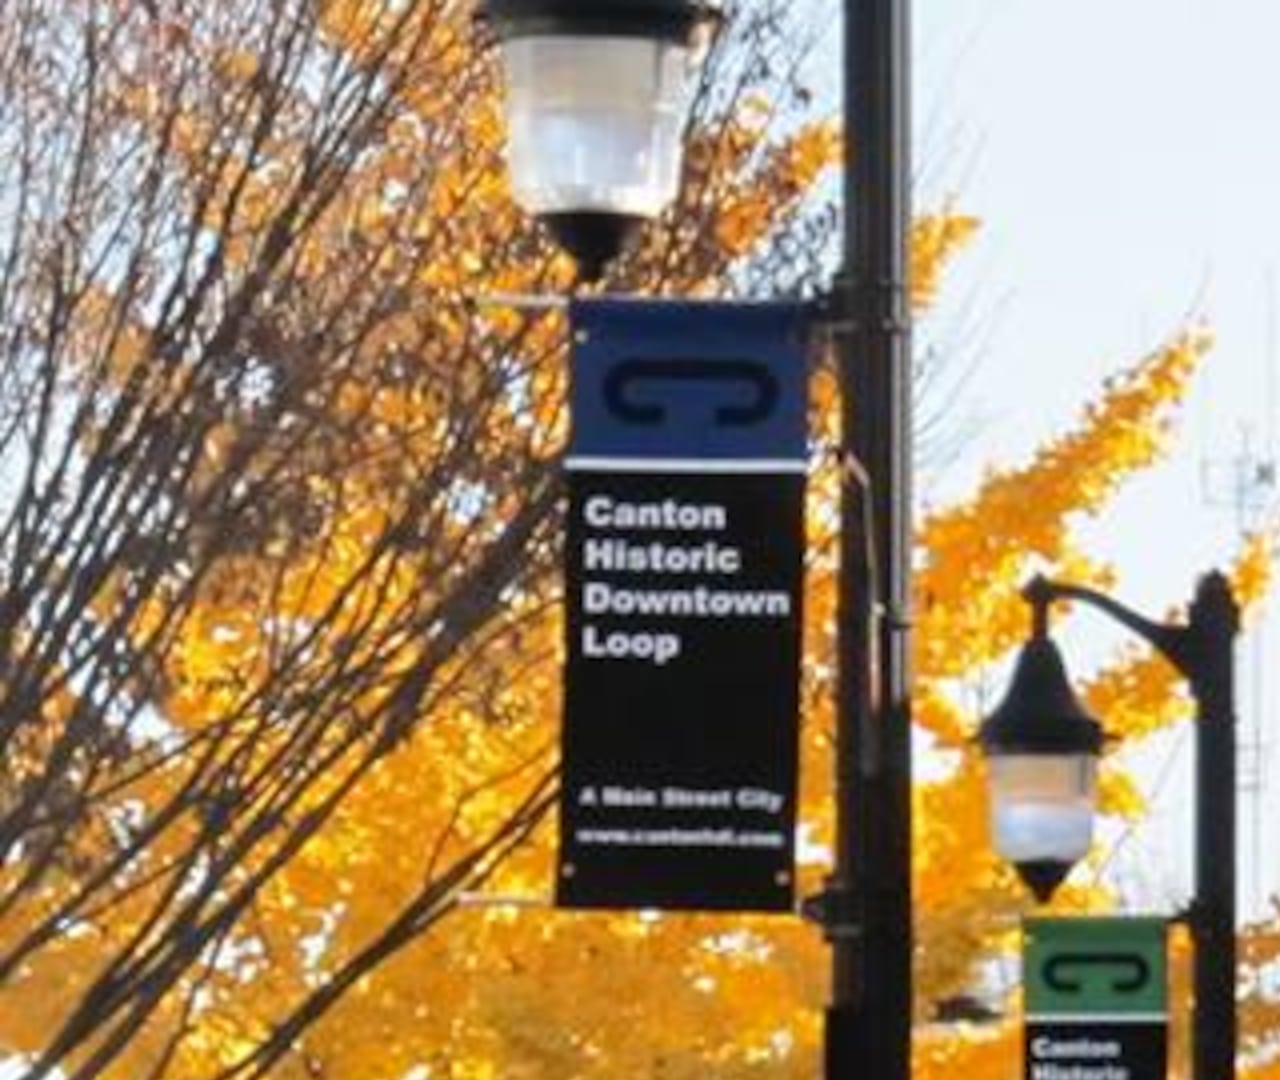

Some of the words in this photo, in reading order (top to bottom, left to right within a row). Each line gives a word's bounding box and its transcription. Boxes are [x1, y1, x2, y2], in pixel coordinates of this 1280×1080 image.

[583, 494, 727, 530] Canton
[583, 538, 742, 573] Historic
[582, 582, 791, 616] Downtown
[581, 624, 681, 664] Loop
[736, 787, 784, 814] City
[1031, 1036, 1122, 1059] Canton
